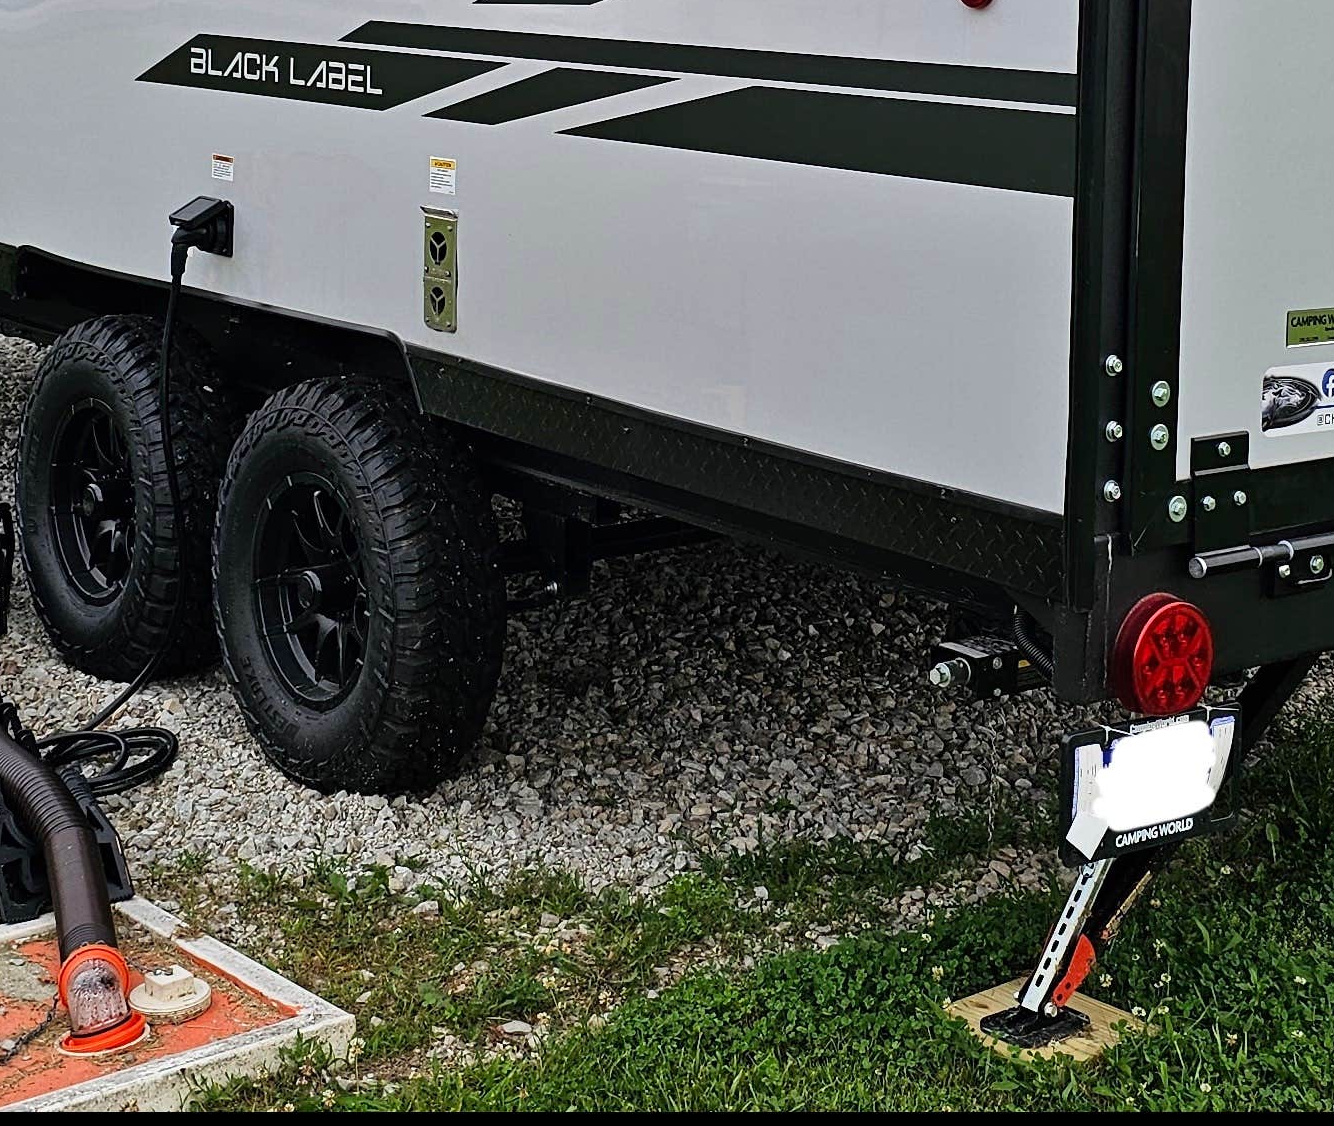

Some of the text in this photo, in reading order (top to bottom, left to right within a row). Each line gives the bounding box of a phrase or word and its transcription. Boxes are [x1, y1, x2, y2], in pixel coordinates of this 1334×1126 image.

[190, 47, 383, 95] BLACK LABEL
[1290, 314, 1327, 328] CAMPING
[1115, 817, 1194, 848] CAMPING WORLD
